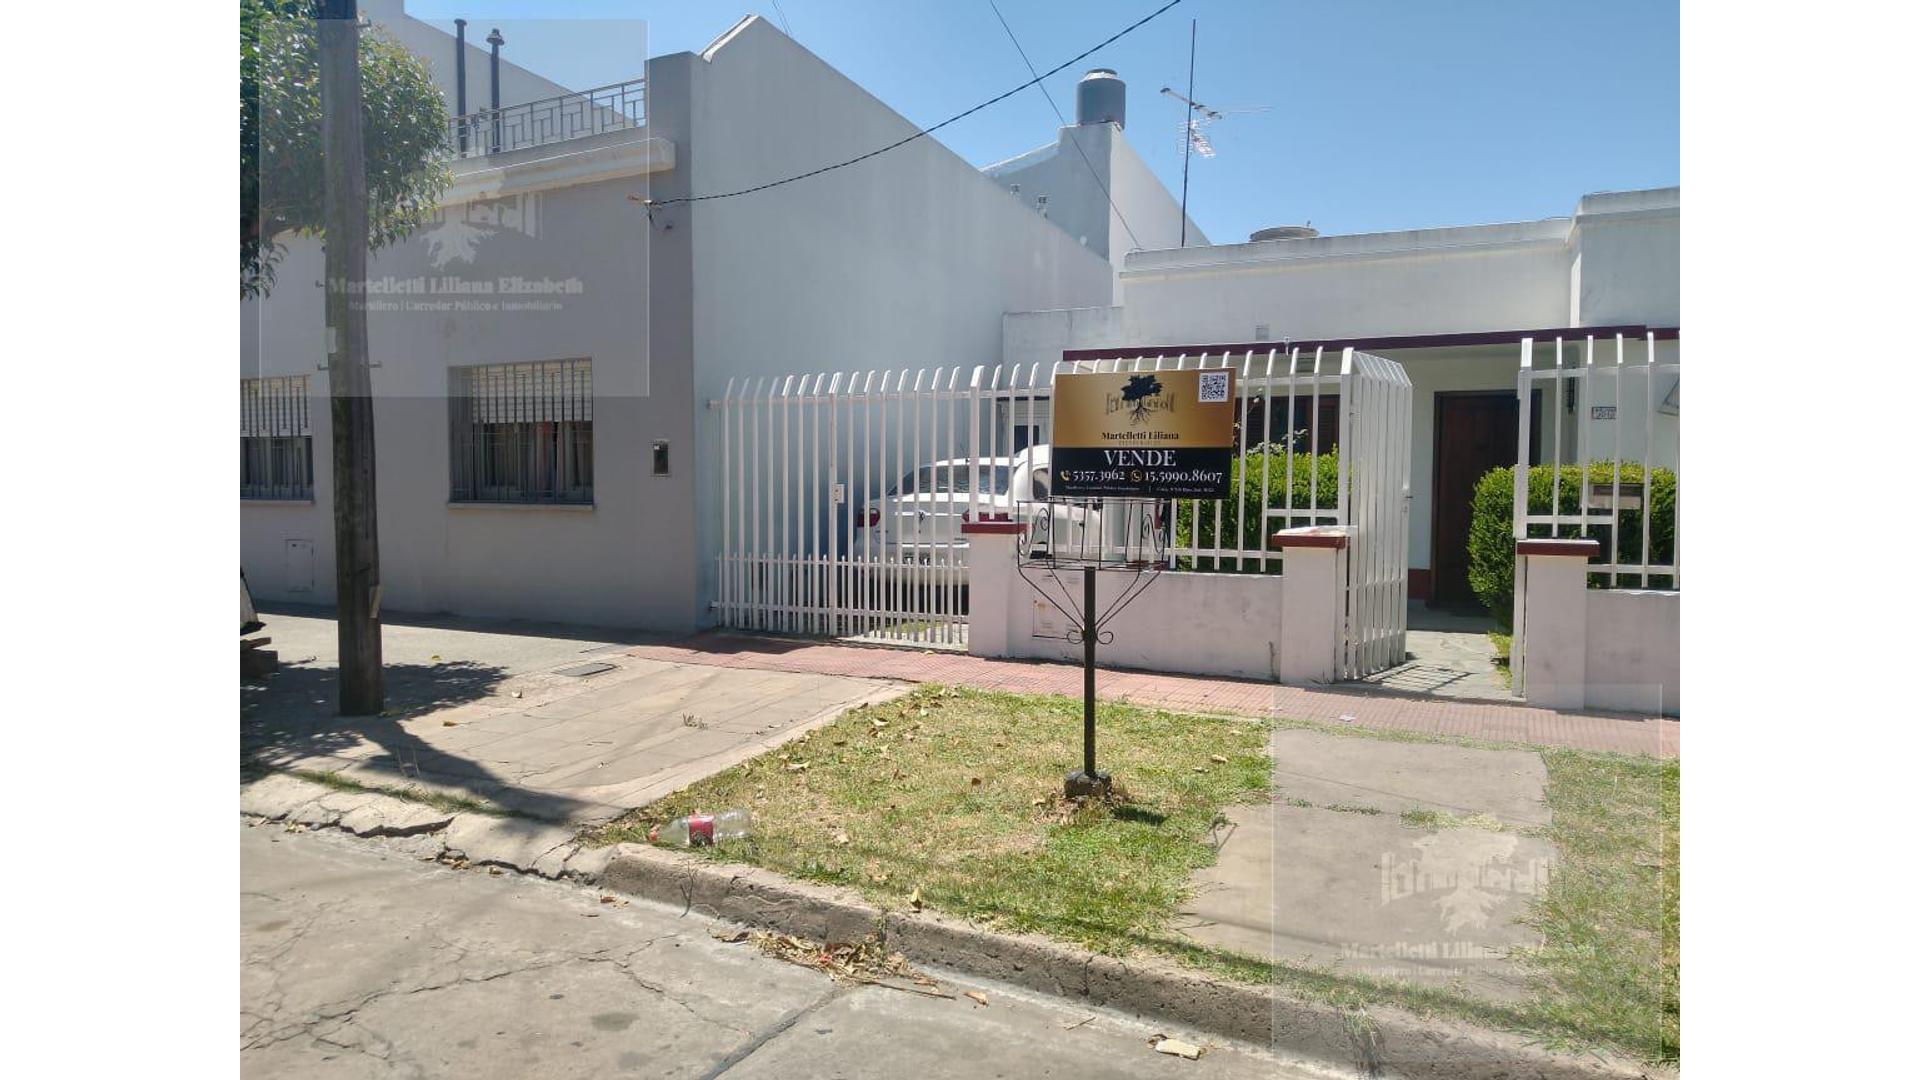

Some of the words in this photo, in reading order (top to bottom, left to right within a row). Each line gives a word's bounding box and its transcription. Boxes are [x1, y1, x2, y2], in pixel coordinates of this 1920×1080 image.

[1102, 431, 1147, 440] Martelletti
[1149, 431, 1179, 440] Liliana
[1104, 450, 1177, 466] VENDE
[1073, 469, 1125, 482] 5357.3962
[1145, 469, 1223, 484] 15.5990.8607
